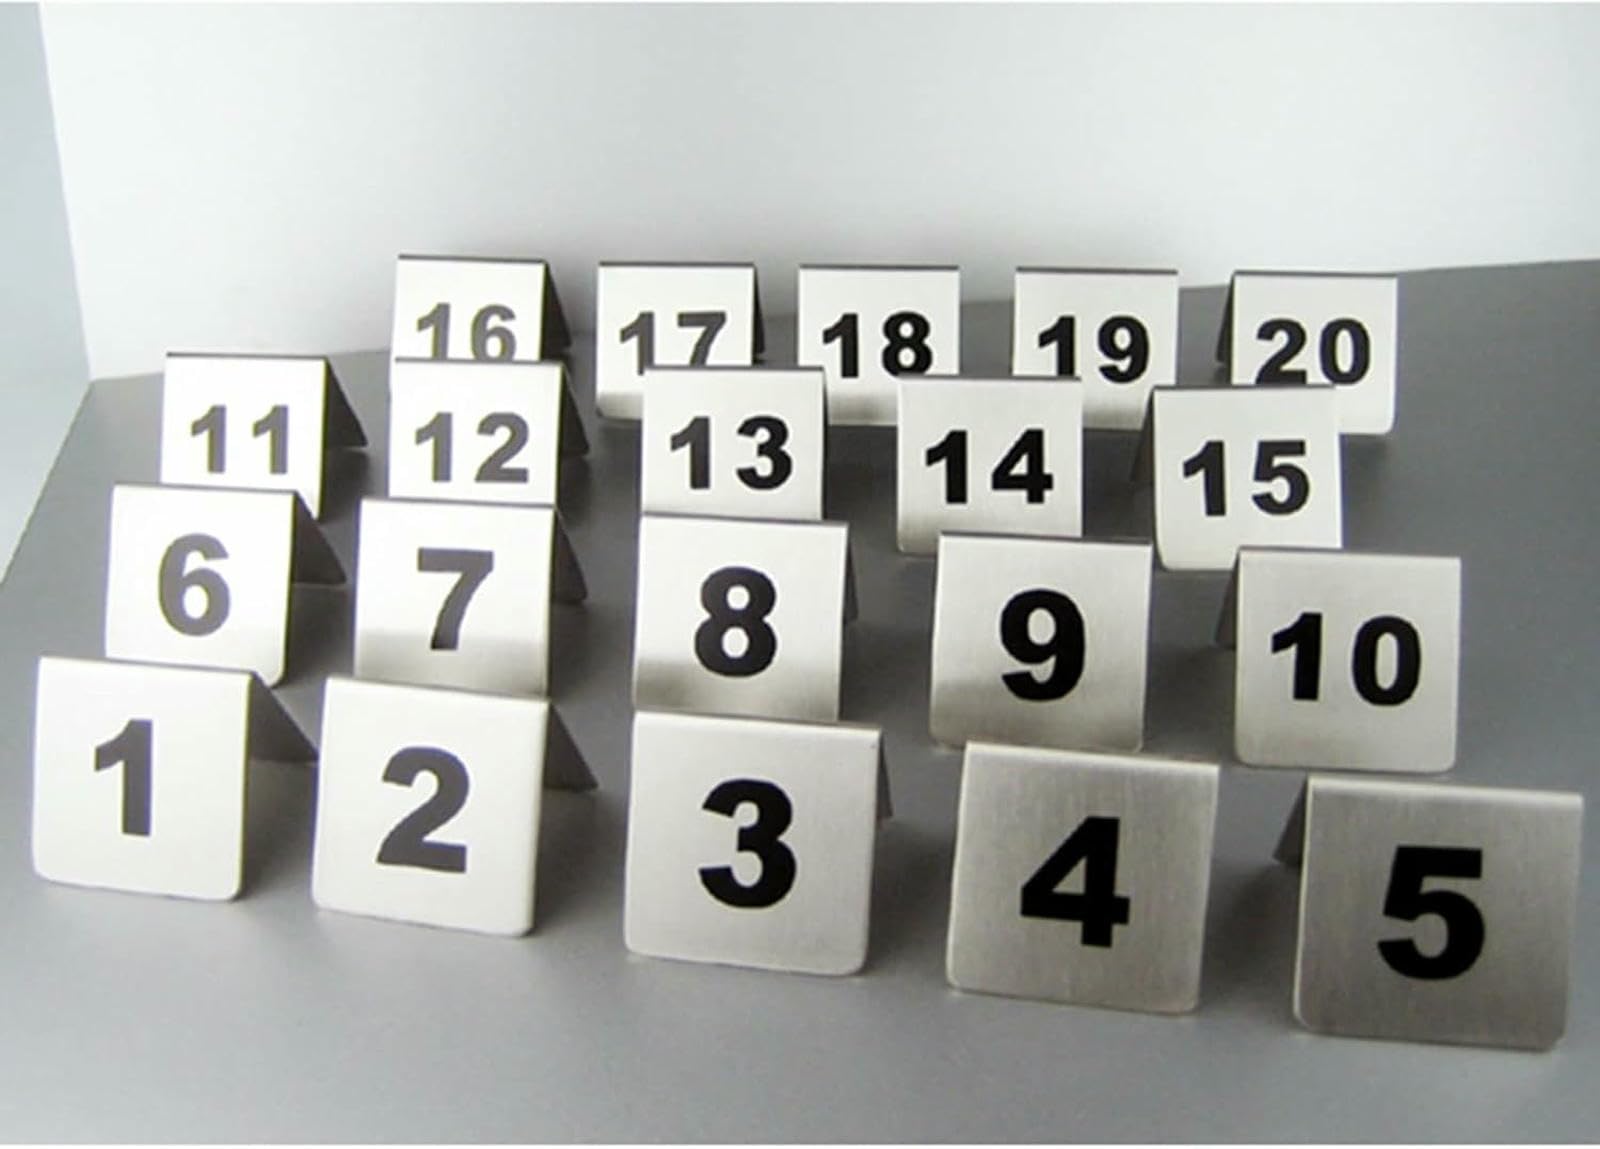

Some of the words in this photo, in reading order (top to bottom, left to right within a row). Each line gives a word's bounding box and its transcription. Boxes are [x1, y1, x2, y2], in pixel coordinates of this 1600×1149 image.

[416, 303, 516, 360] 16
[620, 311, 727, 375] 17
[823, 312, 932, 378] 18
[1038, 316, 1149, 383] 19
[1255, 319, 1370, 384] 20
[191, 405, 288, 474] 11
[416, 413, 529, 483] 12
[671, 416, 792, 490] 13
[926, 429, 1053, 504] 14
[1183, 440, 1309, 516] 15
[158, 534, 230, 636] 6
[418, 548, 493, 651] 7
[695, 567, 777, 678] 8
[1001, 590, 1085, 702] 9
[1272, 613, 1421, 706] 10
[95, 720, 152, 836] 1
[377, 747, 469, 873] 2
[699, 779, 796, 908] 3
[1021, 816, 1130, 948] 4
[1378, 846, 1485, 981] 5
